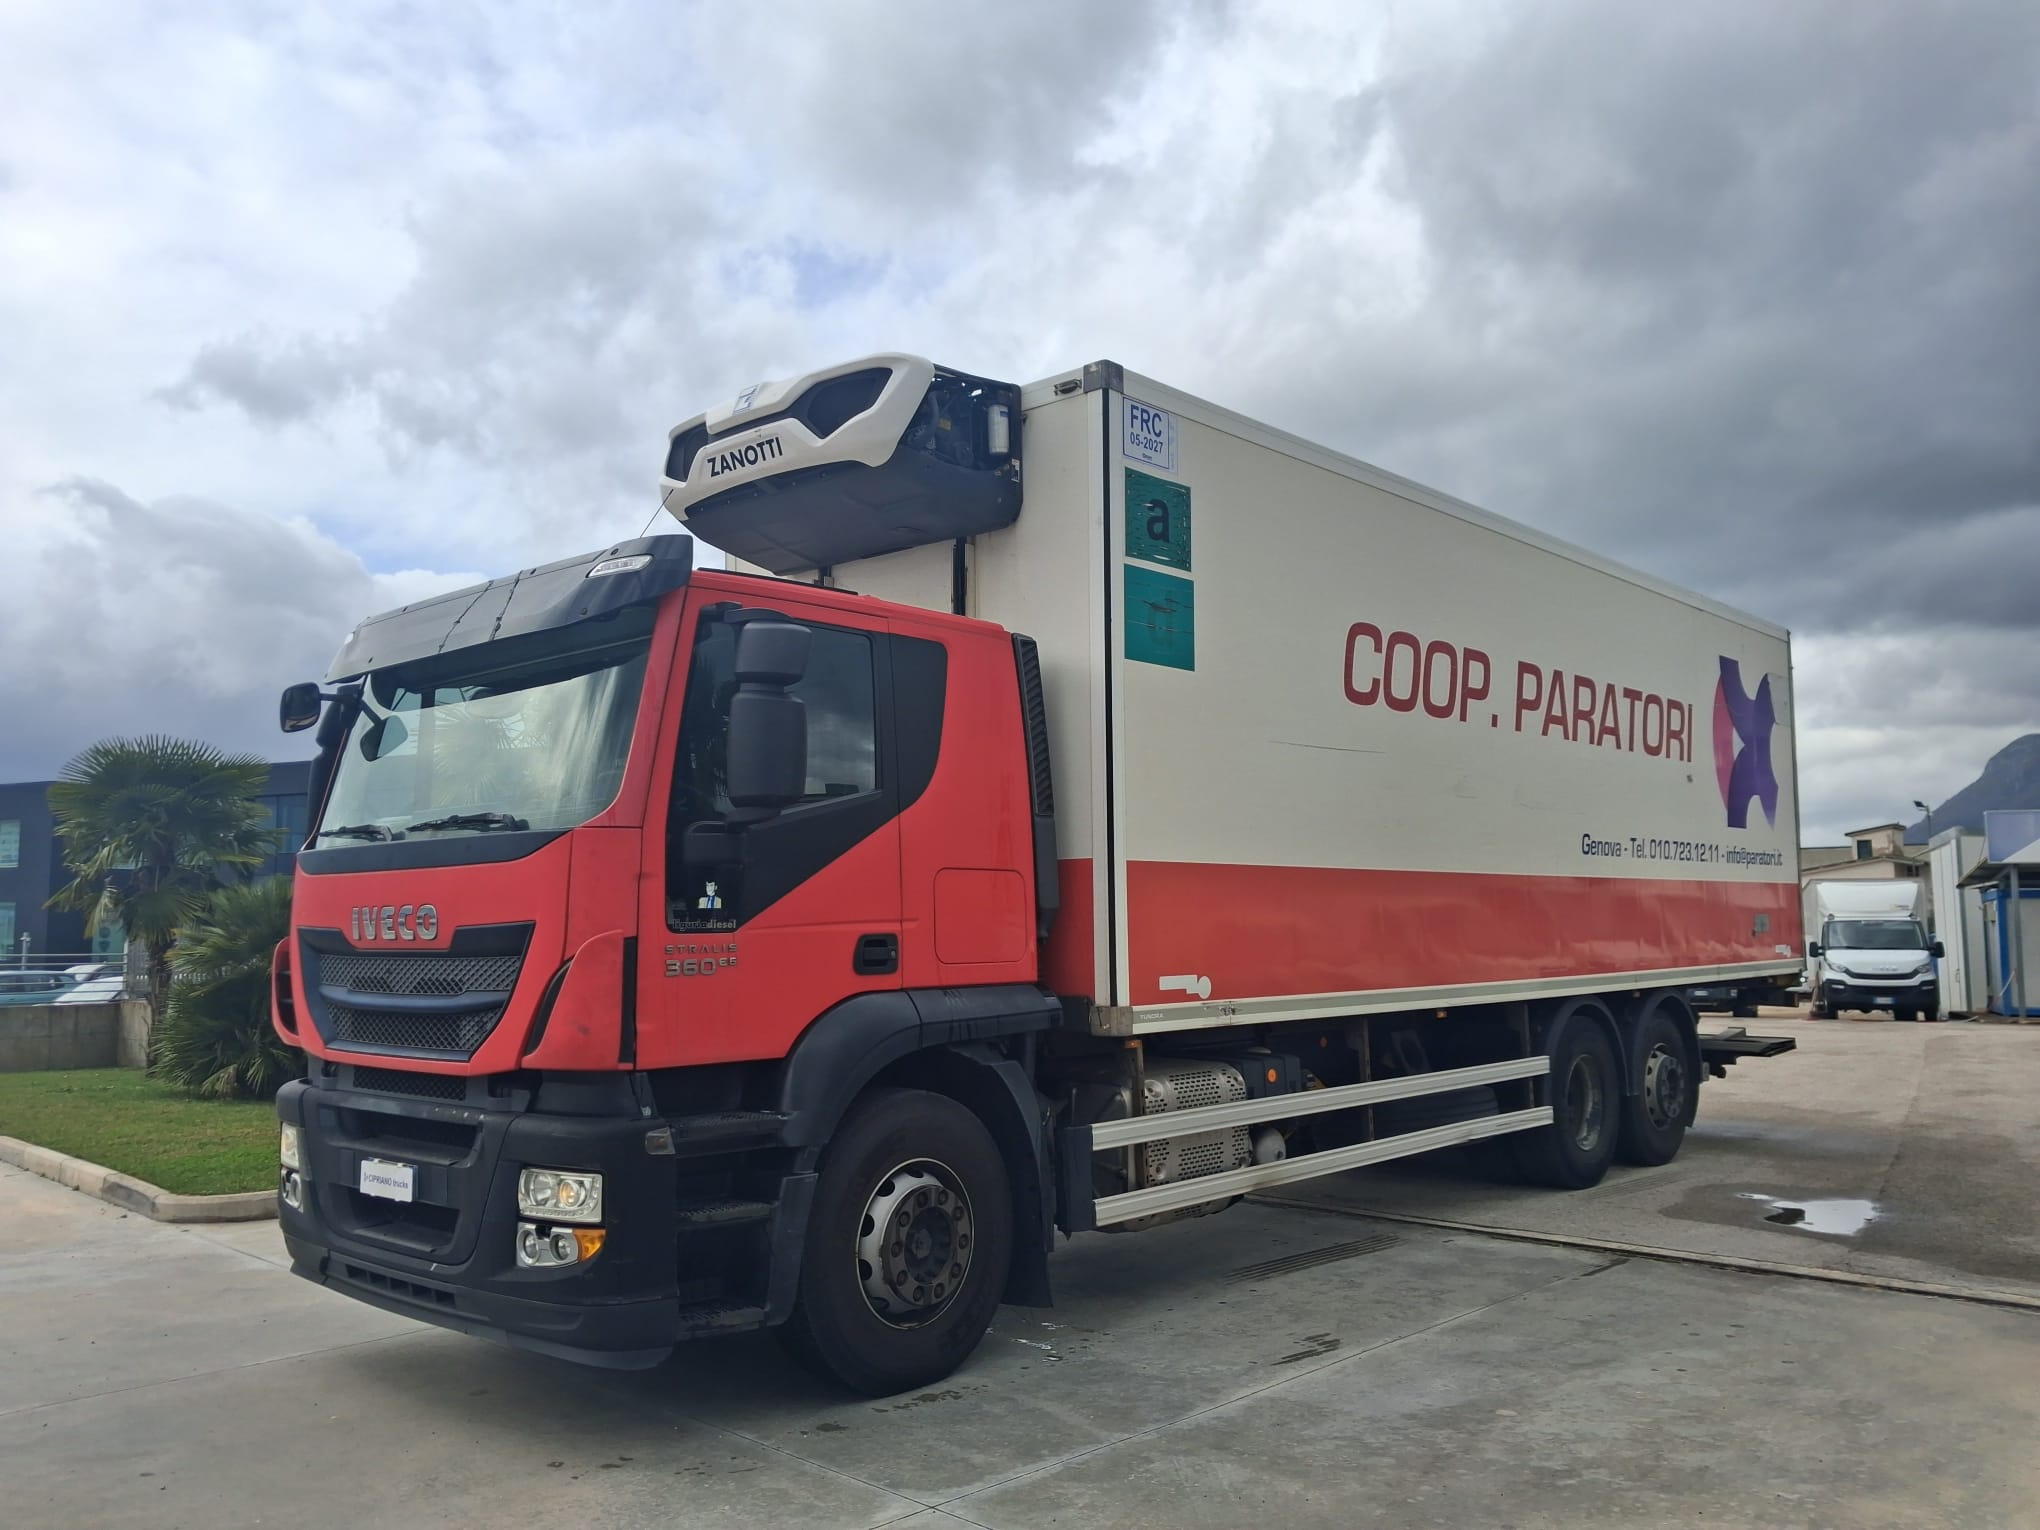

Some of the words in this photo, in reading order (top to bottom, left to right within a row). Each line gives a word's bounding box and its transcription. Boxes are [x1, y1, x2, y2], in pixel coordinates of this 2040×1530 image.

[1130, 403, 1162, 438] FRC
[707, 436, 783, 477] ZANOTTI
[1129, 431, 1164, 454] 05-2027
[1146, 498, 1171, 544] a
[1343, 621, 1499, 728] COOP.
[1514, 660, 1692, 763] PARATORI
[1581, 833, 1622, 857] Genova
[1629, 837, 1648, 859] Tel.
[351, 904, 438, 941] IVECO
[665, 943, 737, 955] STRALIS
[664, 957, 716, 977] 360
[368, 1174, 392, 1186] CIPRIANO
